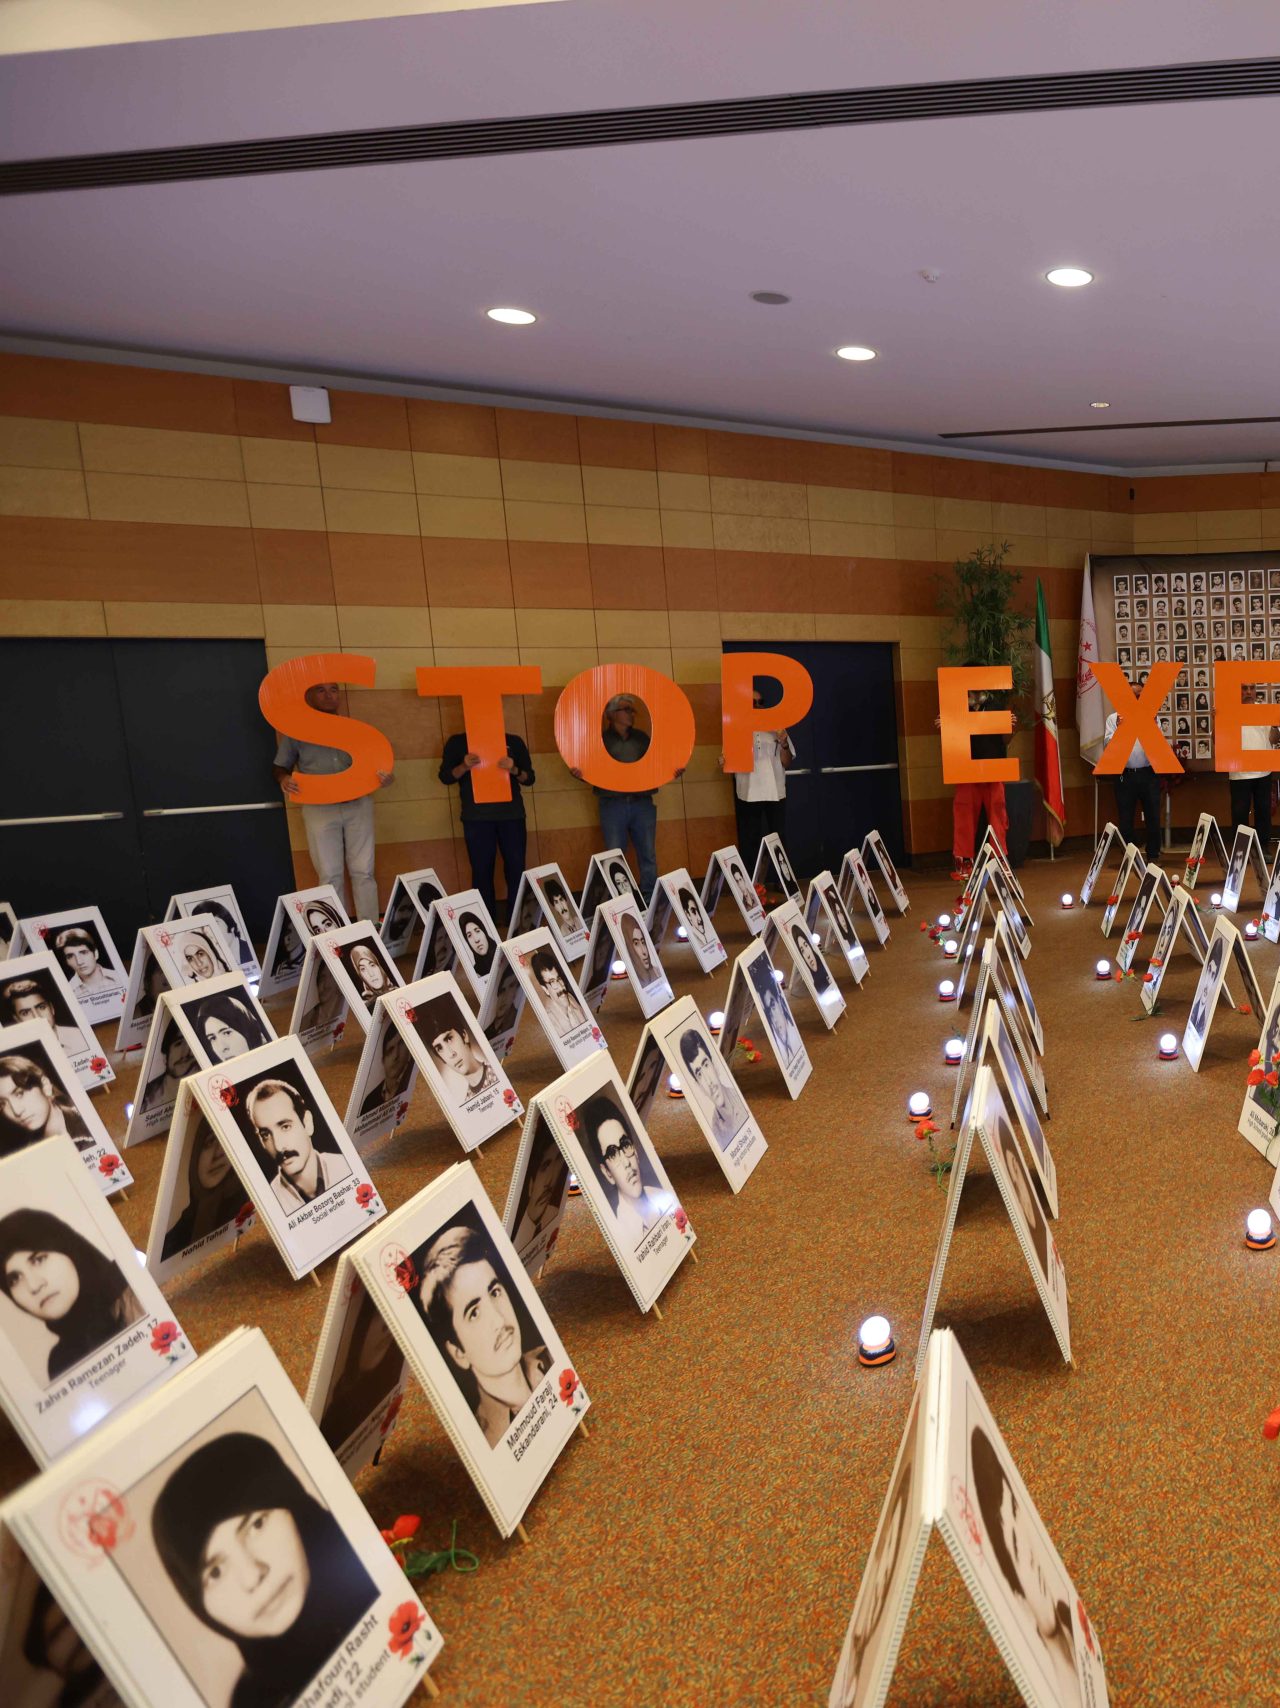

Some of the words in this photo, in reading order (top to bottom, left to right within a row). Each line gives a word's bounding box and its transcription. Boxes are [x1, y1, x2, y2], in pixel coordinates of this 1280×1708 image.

[259, 652, 814, 805] STOP
[288, 1219, 297, 1231] Ali
[297, 1207, 314, 1225] Akbar
[313, 1194, 335, 1214] Bozorg
[333, 1182, 354, 1204] Bashar,
[352, 1177, 361, 1189] 33
[312, 1210, 328, 1226] Social
[327, 1198, 346, 1215] worker
[36, 1385, 69, 1415] Zahra
[69, 1351, 116, 1391] Ramezan
[114, 1330, 149, 1357] Zadeh,
[87, 1357, 128, 1390] Teenager
[506, 1403, 539, 1450] Mahmoud
[534, 1380, 553, 1409] Faraji
[512, 1409, 552, 1462] Eskandarani,
[547, 1393, 559, 1411] 24
[302, 1654, 348, 1708] hafouri
[344, 1614, 379, 1658] Rasht
[344, 1661, 363, 1686] 22
[355, 1648, 392, 1699] student
